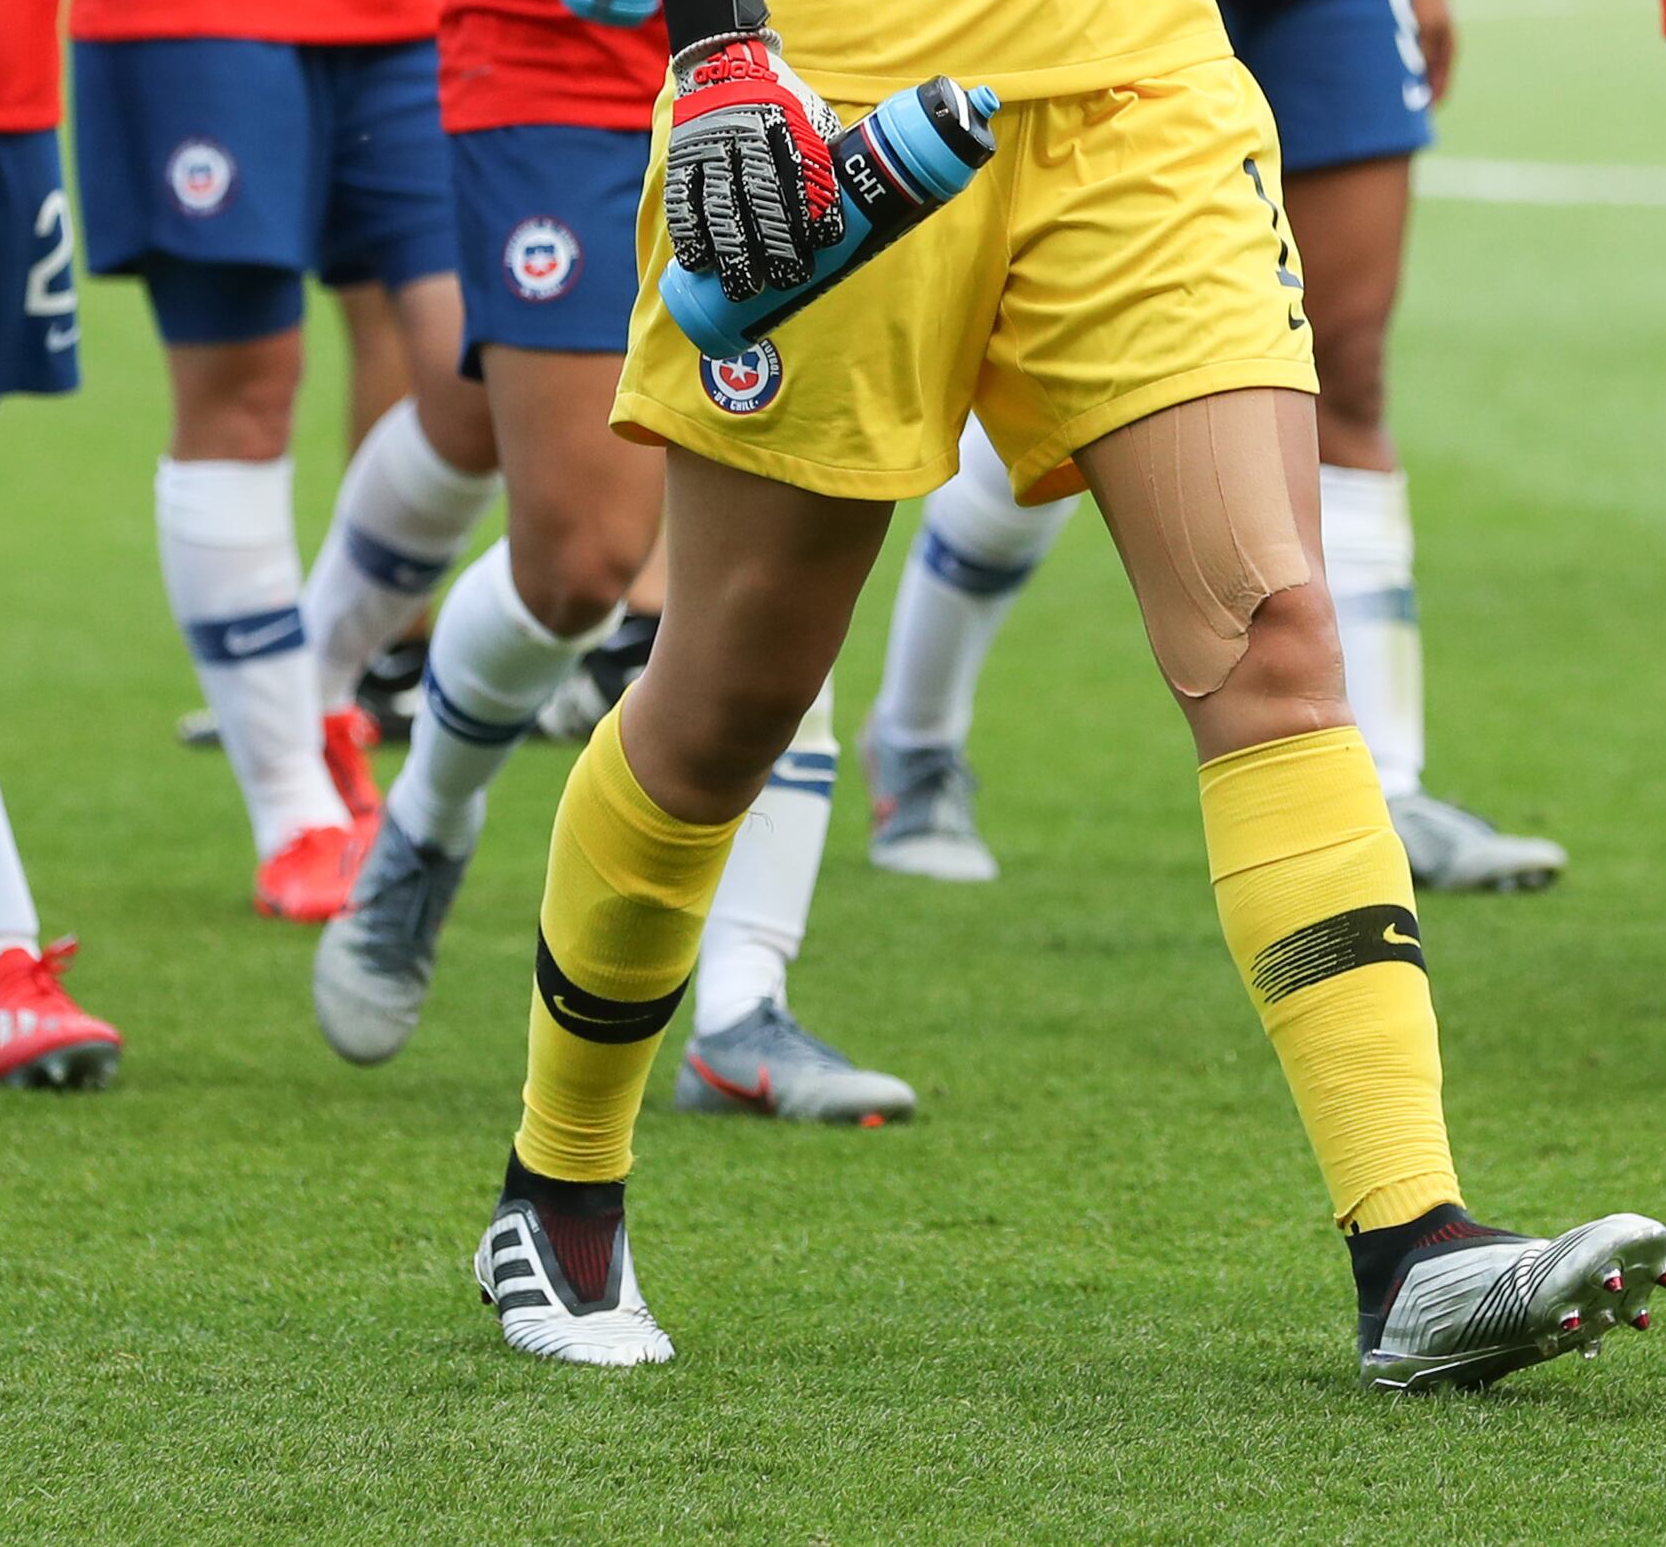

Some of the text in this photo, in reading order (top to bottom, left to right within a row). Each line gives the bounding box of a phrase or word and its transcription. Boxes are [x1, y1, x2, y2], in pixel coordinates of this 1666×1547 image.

[694, 57, 779, 85] adidas
[844, 154, 887, 204] CHI
[760, 339, 780, 376] FUTBOL
